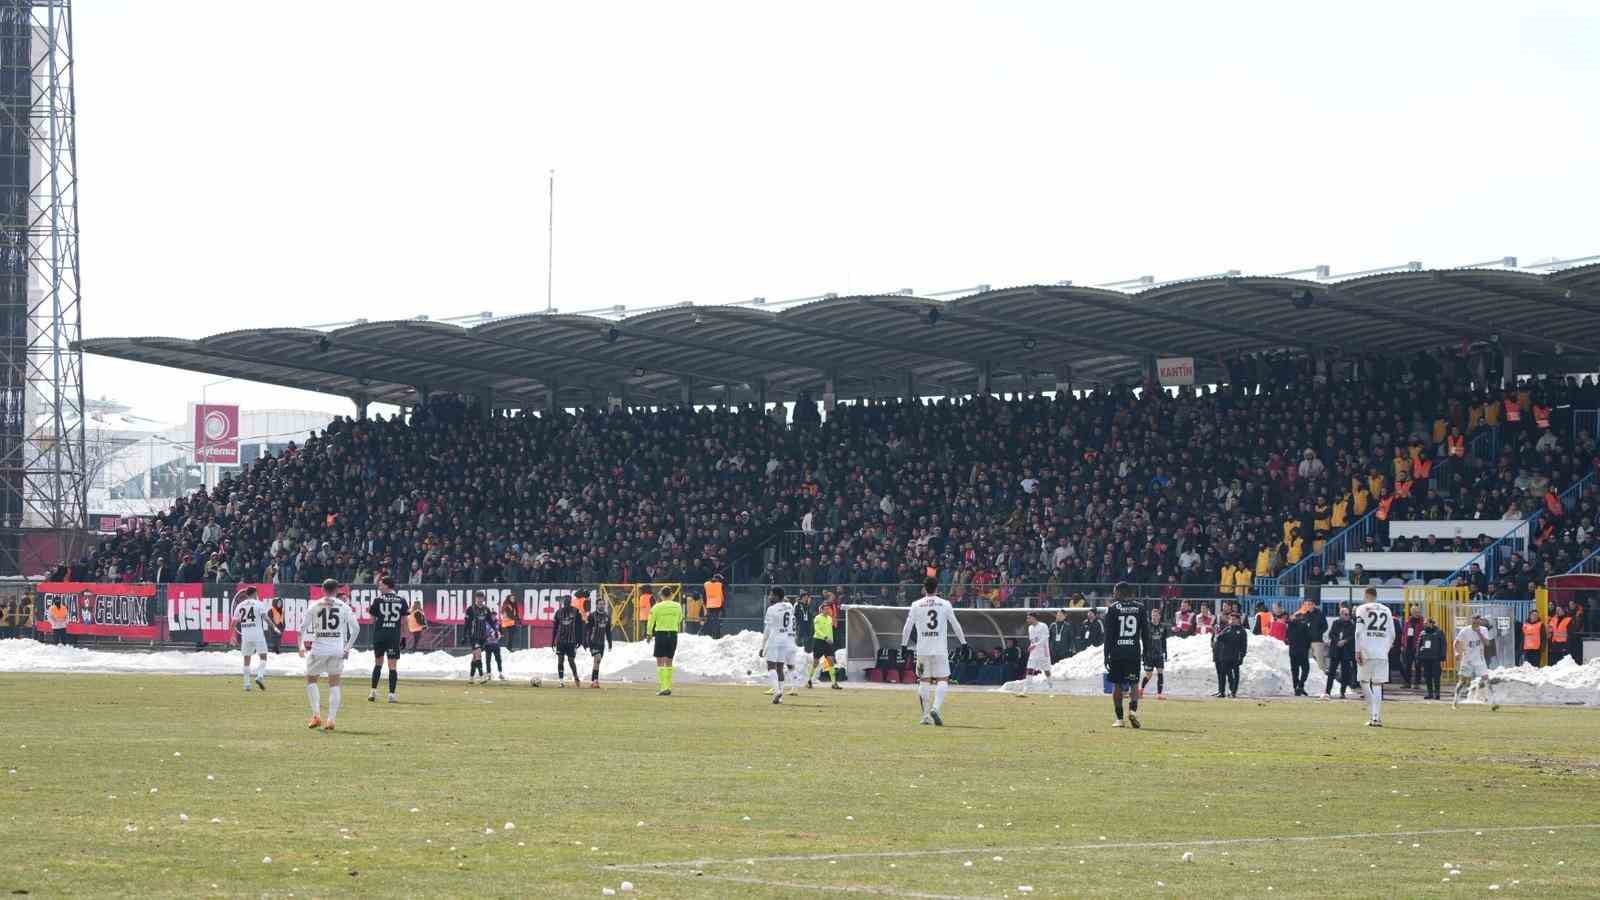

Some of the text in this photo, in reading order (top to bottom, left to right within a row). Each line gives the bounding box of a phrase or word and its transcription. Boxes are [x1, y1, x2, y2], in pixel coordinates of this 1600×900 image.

[167, 588, 230, 631] LİSELİ
[239, 606, 256, 623] 24
[317, 607, 340, 630] 15
[379, 602, 402, 622] 45
[783, 611, 790, 628] 6
[927, 609, 938, 630] 3
[1118, 615, 1137, 637] 19
[1367, 611, 1388, 632] 22
